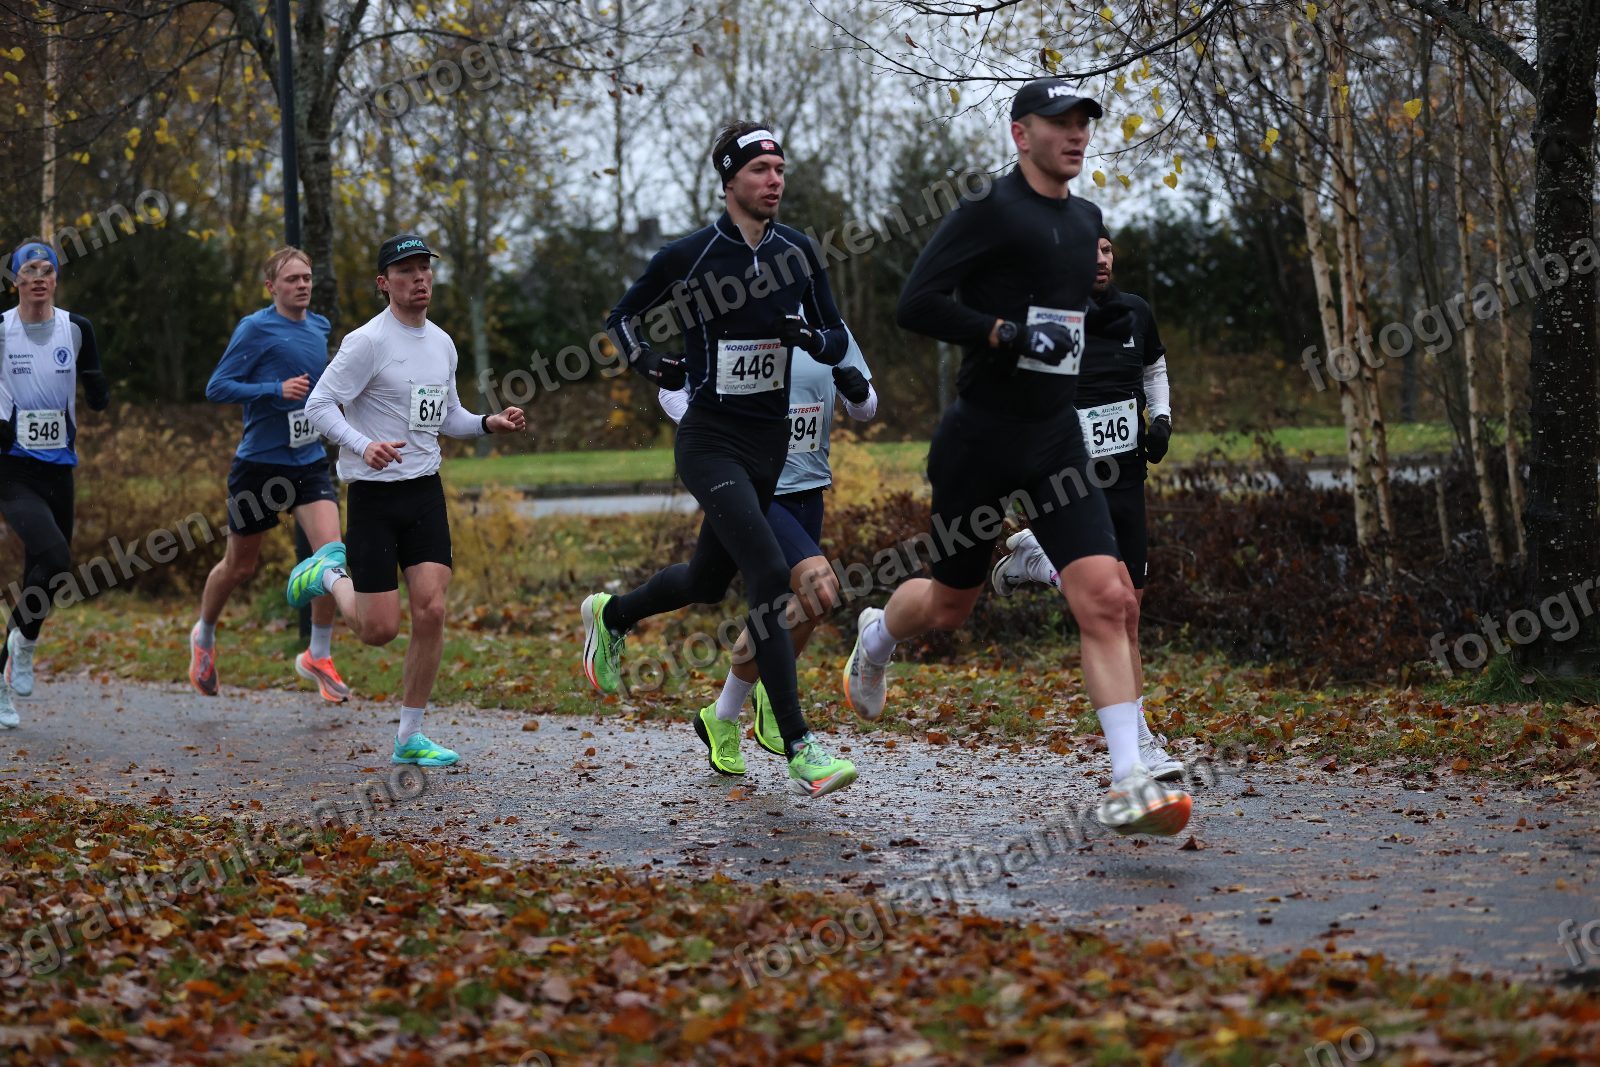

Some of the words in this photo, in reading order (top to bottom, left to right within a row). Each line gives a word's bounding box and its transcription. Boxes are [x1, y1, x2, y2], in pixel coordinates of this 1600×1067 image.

[397, 240, 424, 252] HOKA
[725, 342, 781, 352] NORGESTESTE
[732, 353, 775, 381] 446
[420, 399, 443, 421] 614
[29, 421, 59, 441] 548
[790, 416, 816, 441] 94
[1093, 417, 1129, 446] 546
